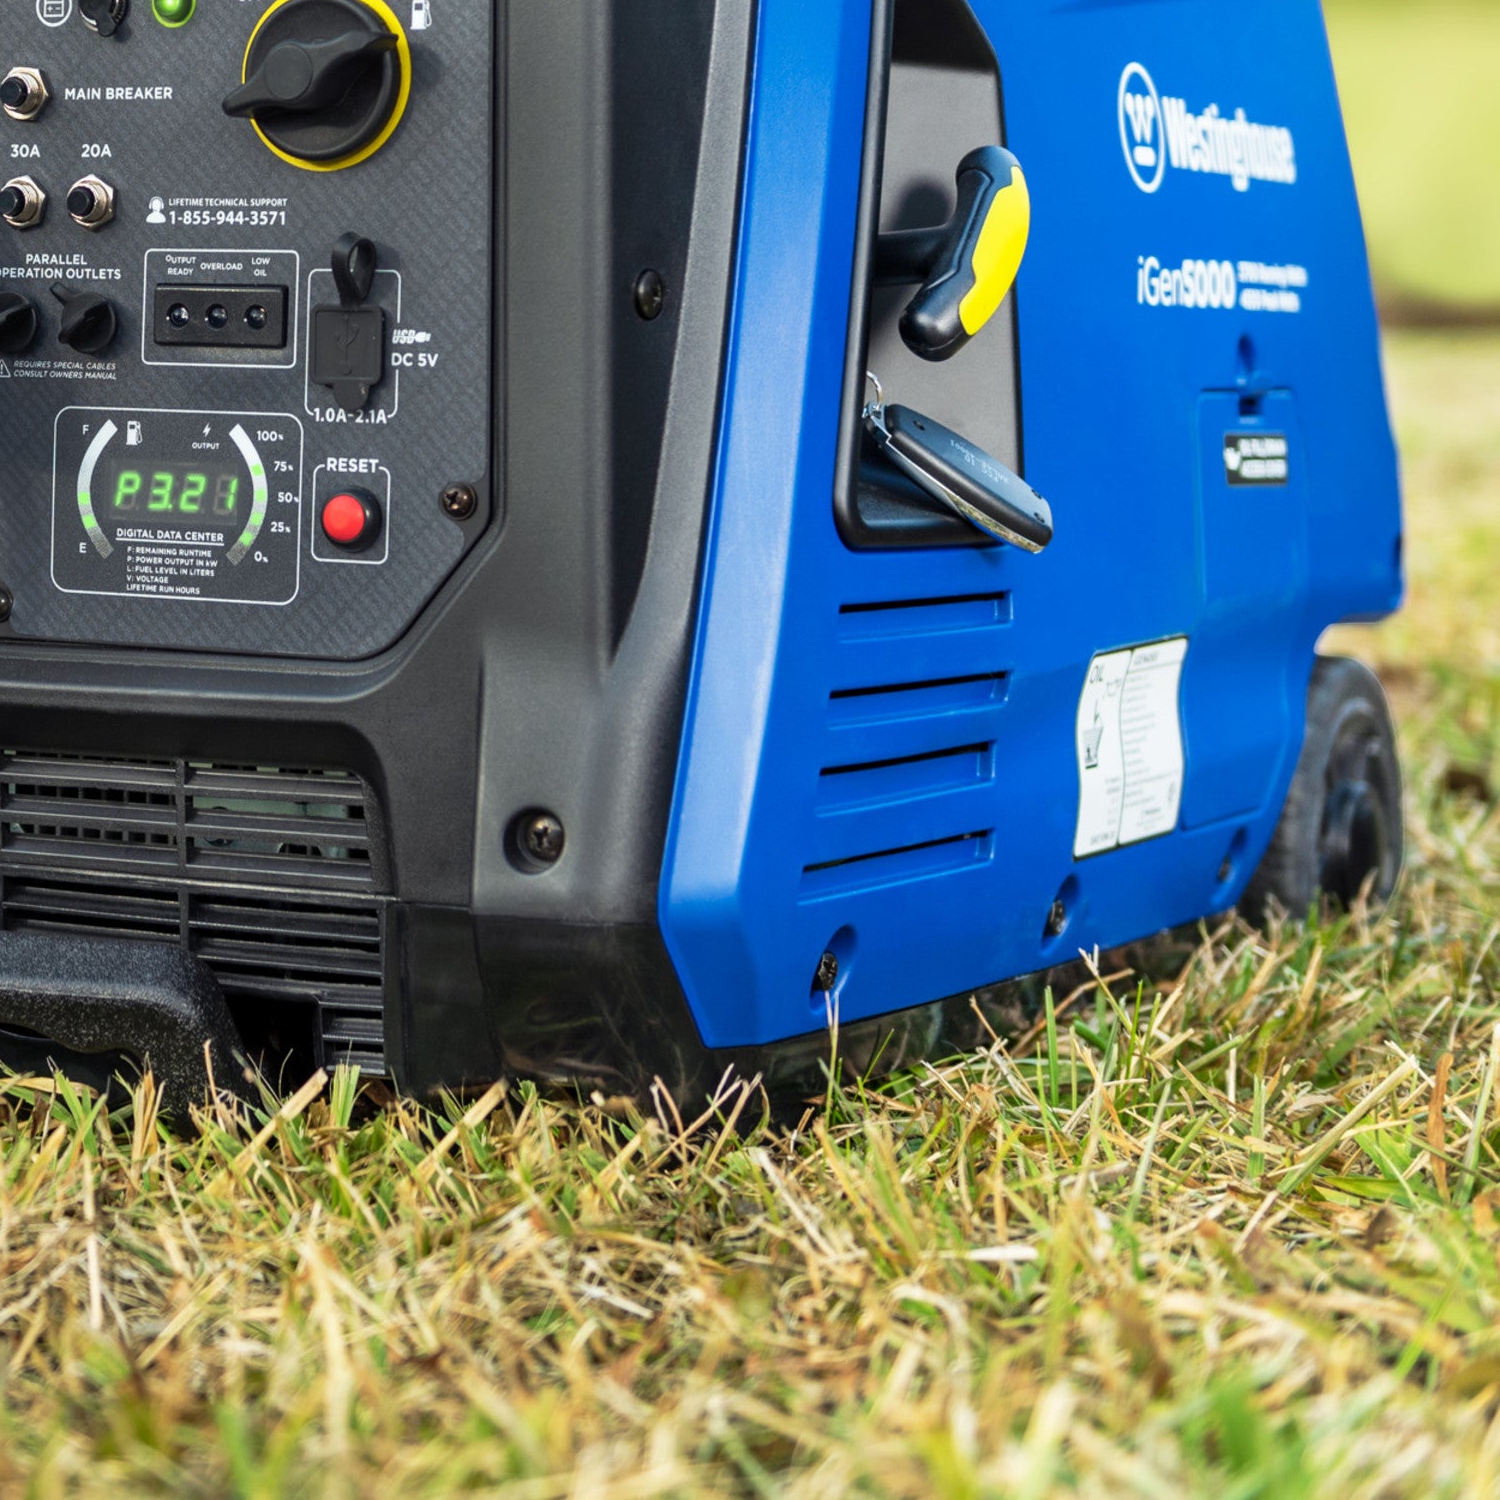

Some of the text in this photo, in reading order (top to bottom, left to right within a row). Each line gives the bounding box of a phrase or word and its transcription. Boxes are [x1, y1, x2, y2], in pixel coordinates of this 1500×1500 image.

[64, 87, 173, 101] MAIN BREAKER
[1162, 95, 1297, 193] Westinghouse
[10, 144, 41, 158] 30A
[81, 144, 112, 158] 20A
[168, 198, 287, 207] LIFETIME TECHNICAL SUPPORT
[169, 210, 286, 225] 1-855-944-3571
[25, 254, 88, 265] PARALLEL
[165, 254, 196, 264] OUTPUT
[251, 257, 270, 265] LOW
[167, 267, 193, 275] READY
[200, 262, 243, 271] OVERLOAD
[66, 268, 122, 280] OUTLETS
[253, 269, 267, 277] OIL
[1137, 255, 1235, 309] iGen5000
[392, 329, 416, 344] USB
[13, 360, 116, 370] REQUIRES SPECIAL CABLES
[391, 353, 439, 367] DC 5V
[13, 369, 117, 380] CONSULT OWNERS MANUAL
[314, 407, 387, 424] 1.0A-2.1A
[82, 424, 90, 435] F
[192, 442, 219, 450] OUTPUT
[326, 457, 380, 473] RESET
[116, 528, 224, 542] DIGITAL DATA CENTER
[79, 542, 87, 553] E
[135, 546, 177, 556] REMAINING
[179, 548, 212, 558] RUNTIME
[136, 556, 163, 564] POWER
[164, 558, 194, 566] OUTPUT
[135, 566, 153, 574] FUEL
[155, 567, 178, 575] LEVEL
[189, 568, 214, 577] LITERS
[136, 575, 169, 584] VOLTAGE
[126, 584, 200, 595] LIFETIME RUN HOURS
